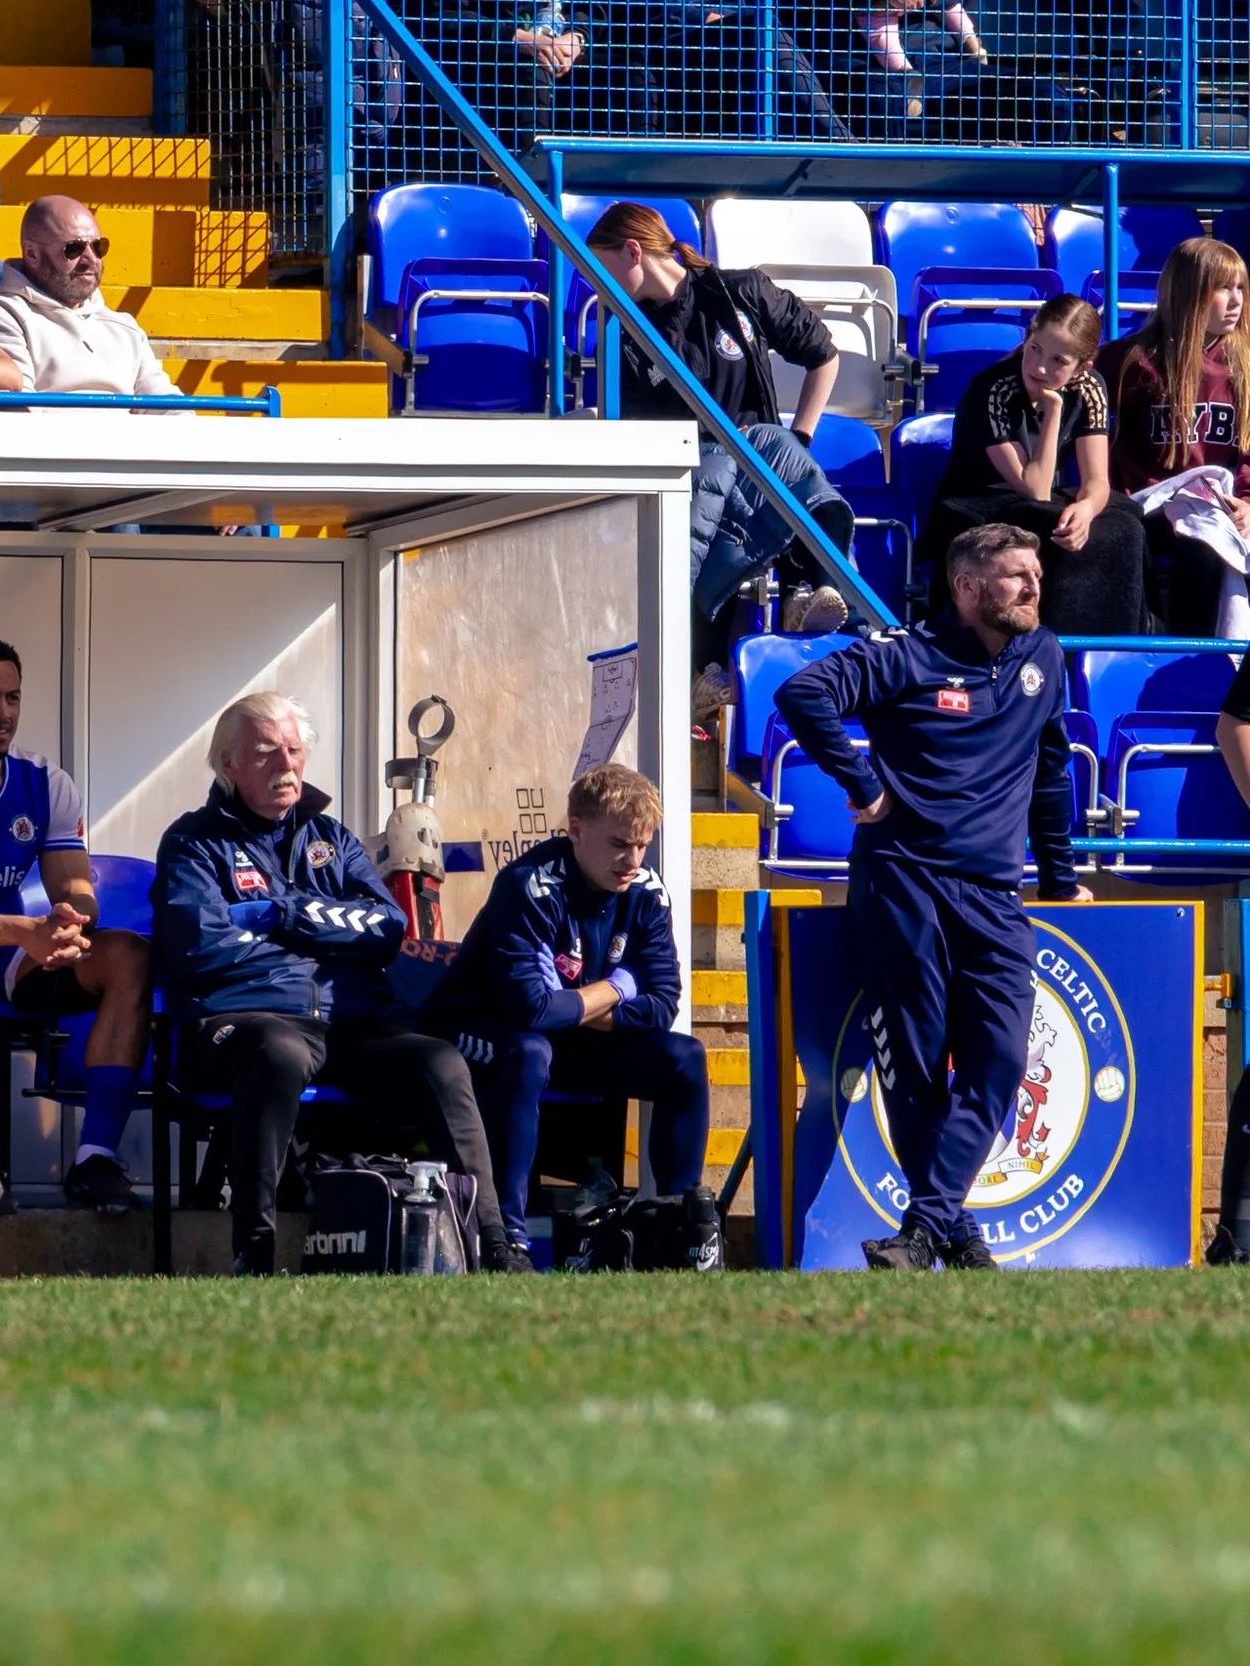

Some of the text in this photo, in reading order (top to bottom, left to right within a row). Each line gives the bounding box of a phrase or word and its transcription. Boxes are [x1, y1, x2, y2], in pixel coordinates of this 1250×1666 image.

[1036, 949, 1106, 1033] CELTIC
[1007, 1160, 1035, 1169] NIHIL
[876, 1172, 1085, 1245] FOLL CLUB
